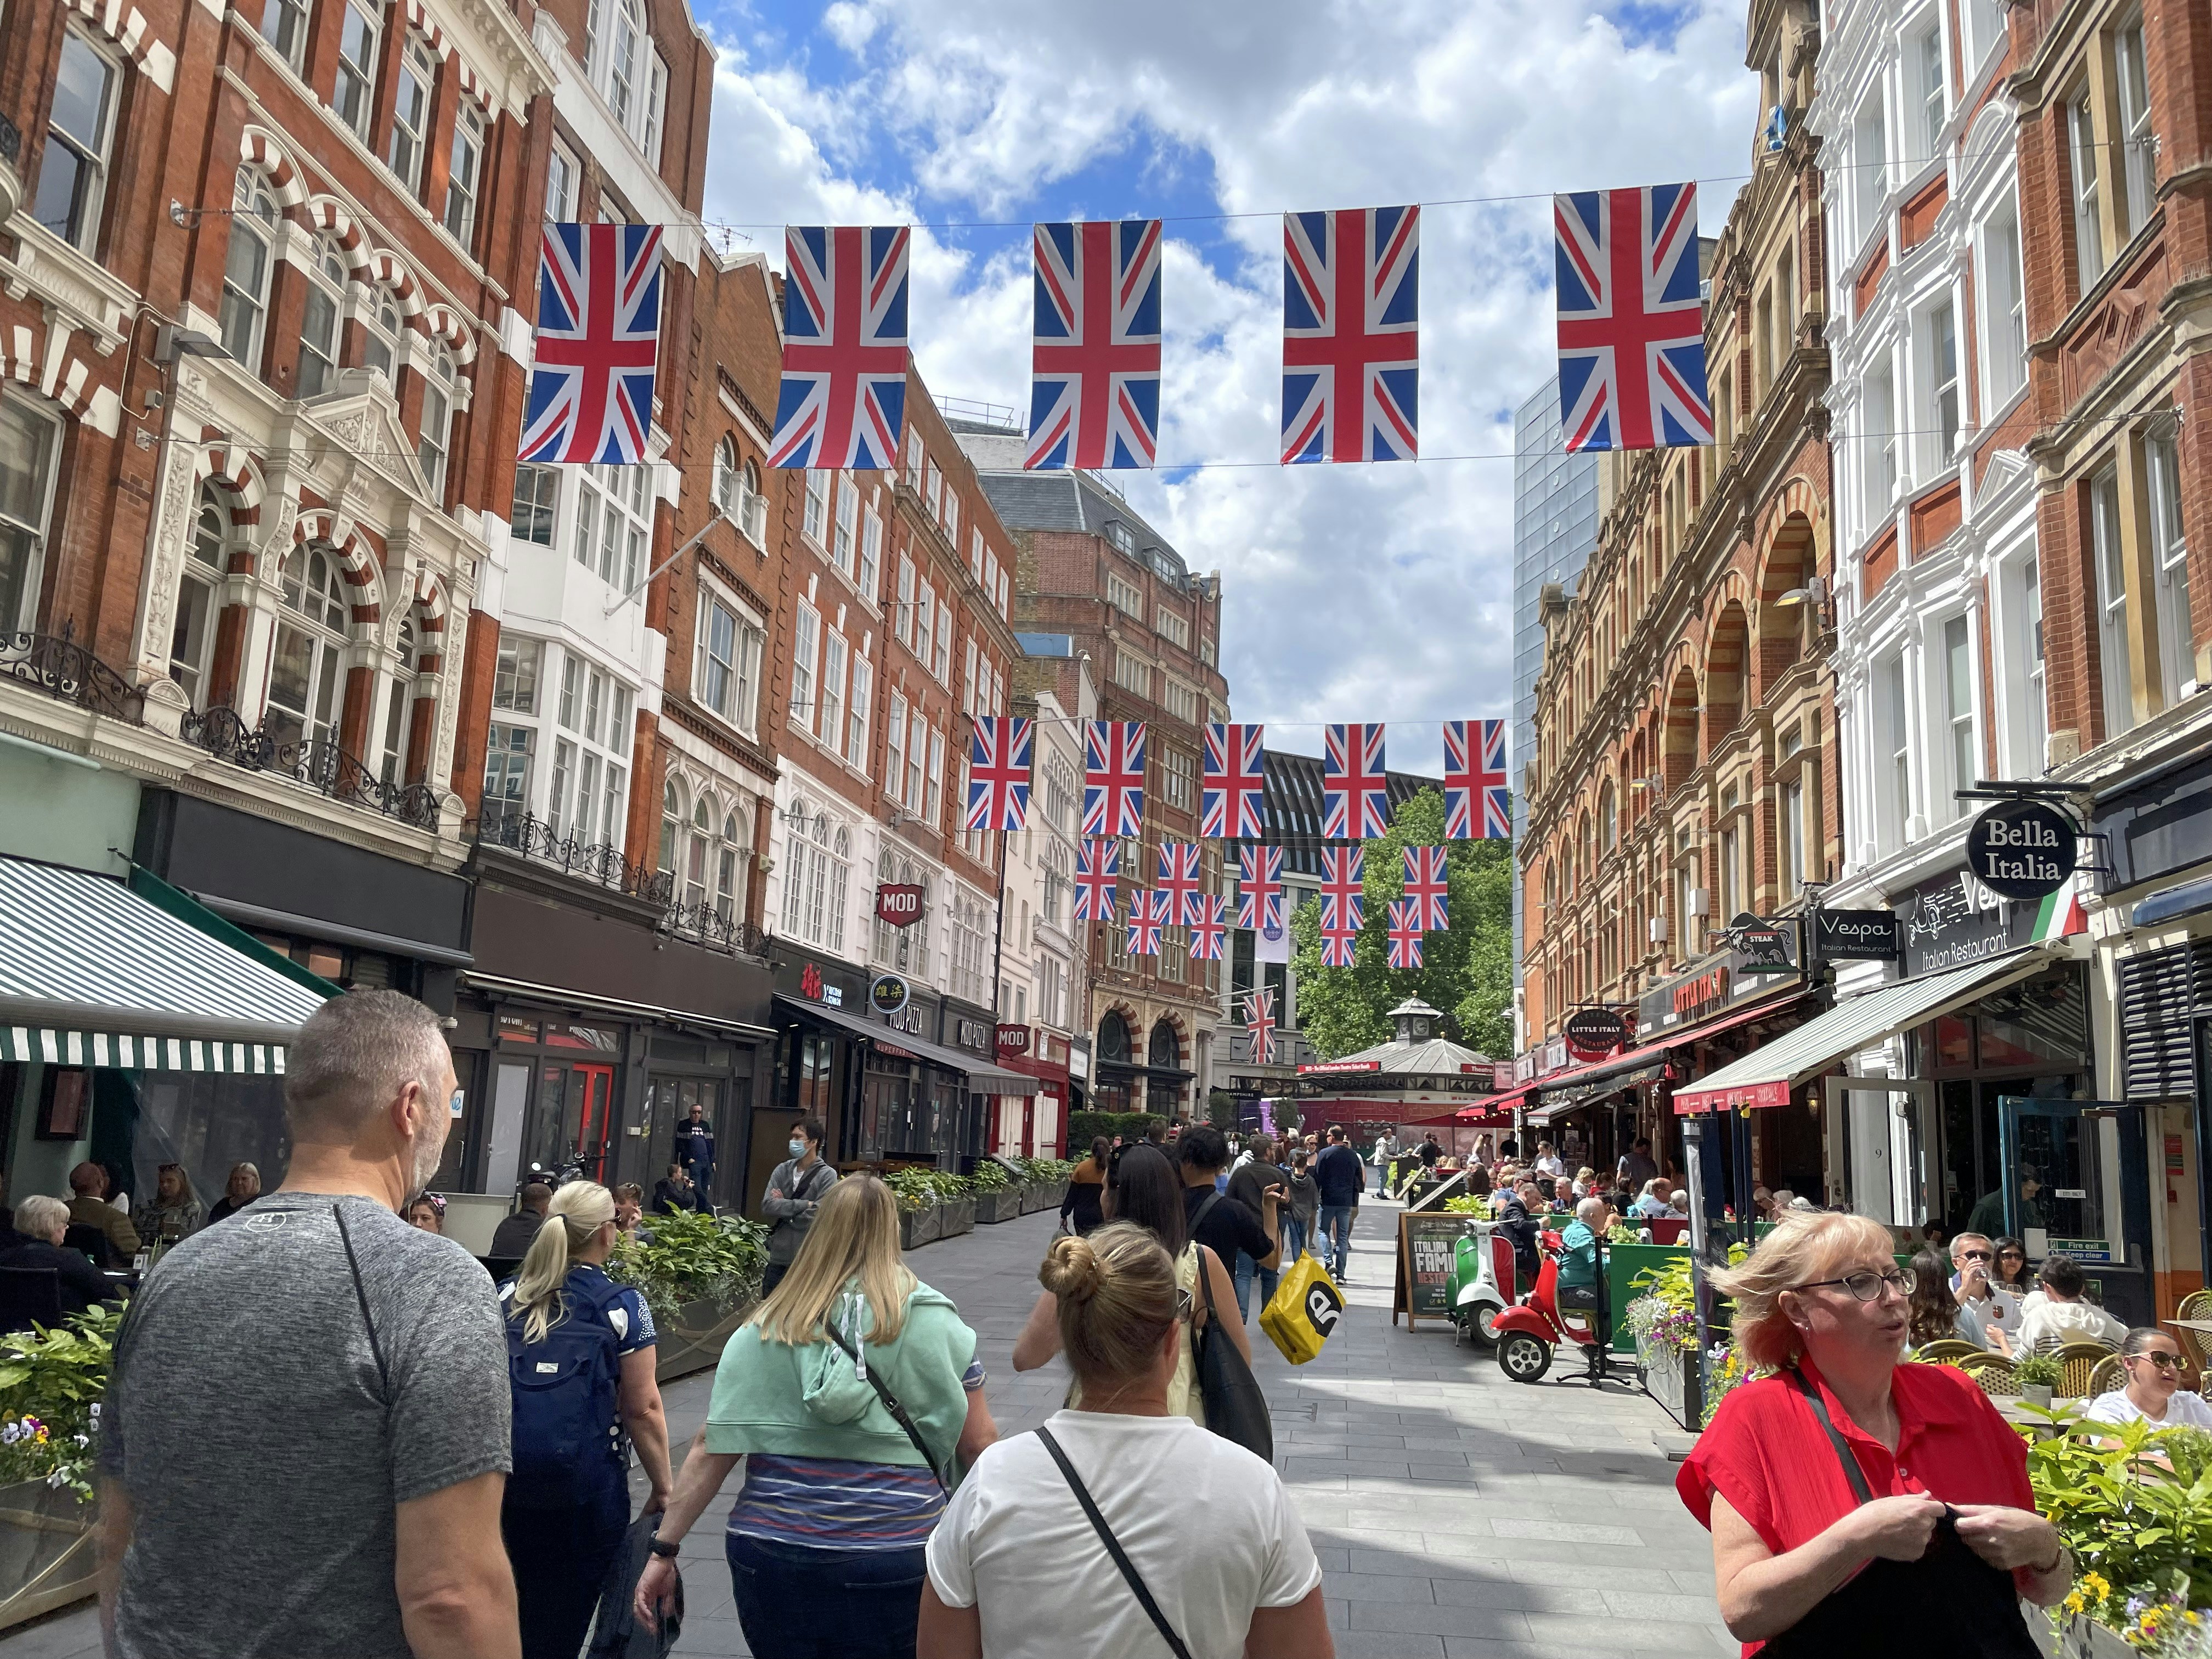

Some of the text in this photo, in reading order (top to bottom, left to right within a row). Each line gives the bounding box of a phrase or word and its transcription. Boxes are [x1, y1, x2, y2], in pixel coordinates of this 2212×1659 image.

[1985, 819, 2059, 847] Bella
[1985, 853, 2062, 880] Italia
[883, 893, 917, 912] MOD
[1820, 915, 1892, 943] Vespa
[1847, 944, 1891, 952] Restaurant
[1922, 927, 2007, 972] Italian Restaurant
[1674, 980, 1698, 1013] LITTLE
[905, 1005, 922, 1035] PIZZA
[961, 1019, 985, 1049] MOD PIZZA
[998, 1031, 1024, 1046] MOD
[1575, 1034, 1619, 1047] RESTAURANT
[1572, 1045, 1578, 1053] &
[1875, 1149, 1882, 1159] 9
[1414, 1241, 1448, 1253] ITALIAN
